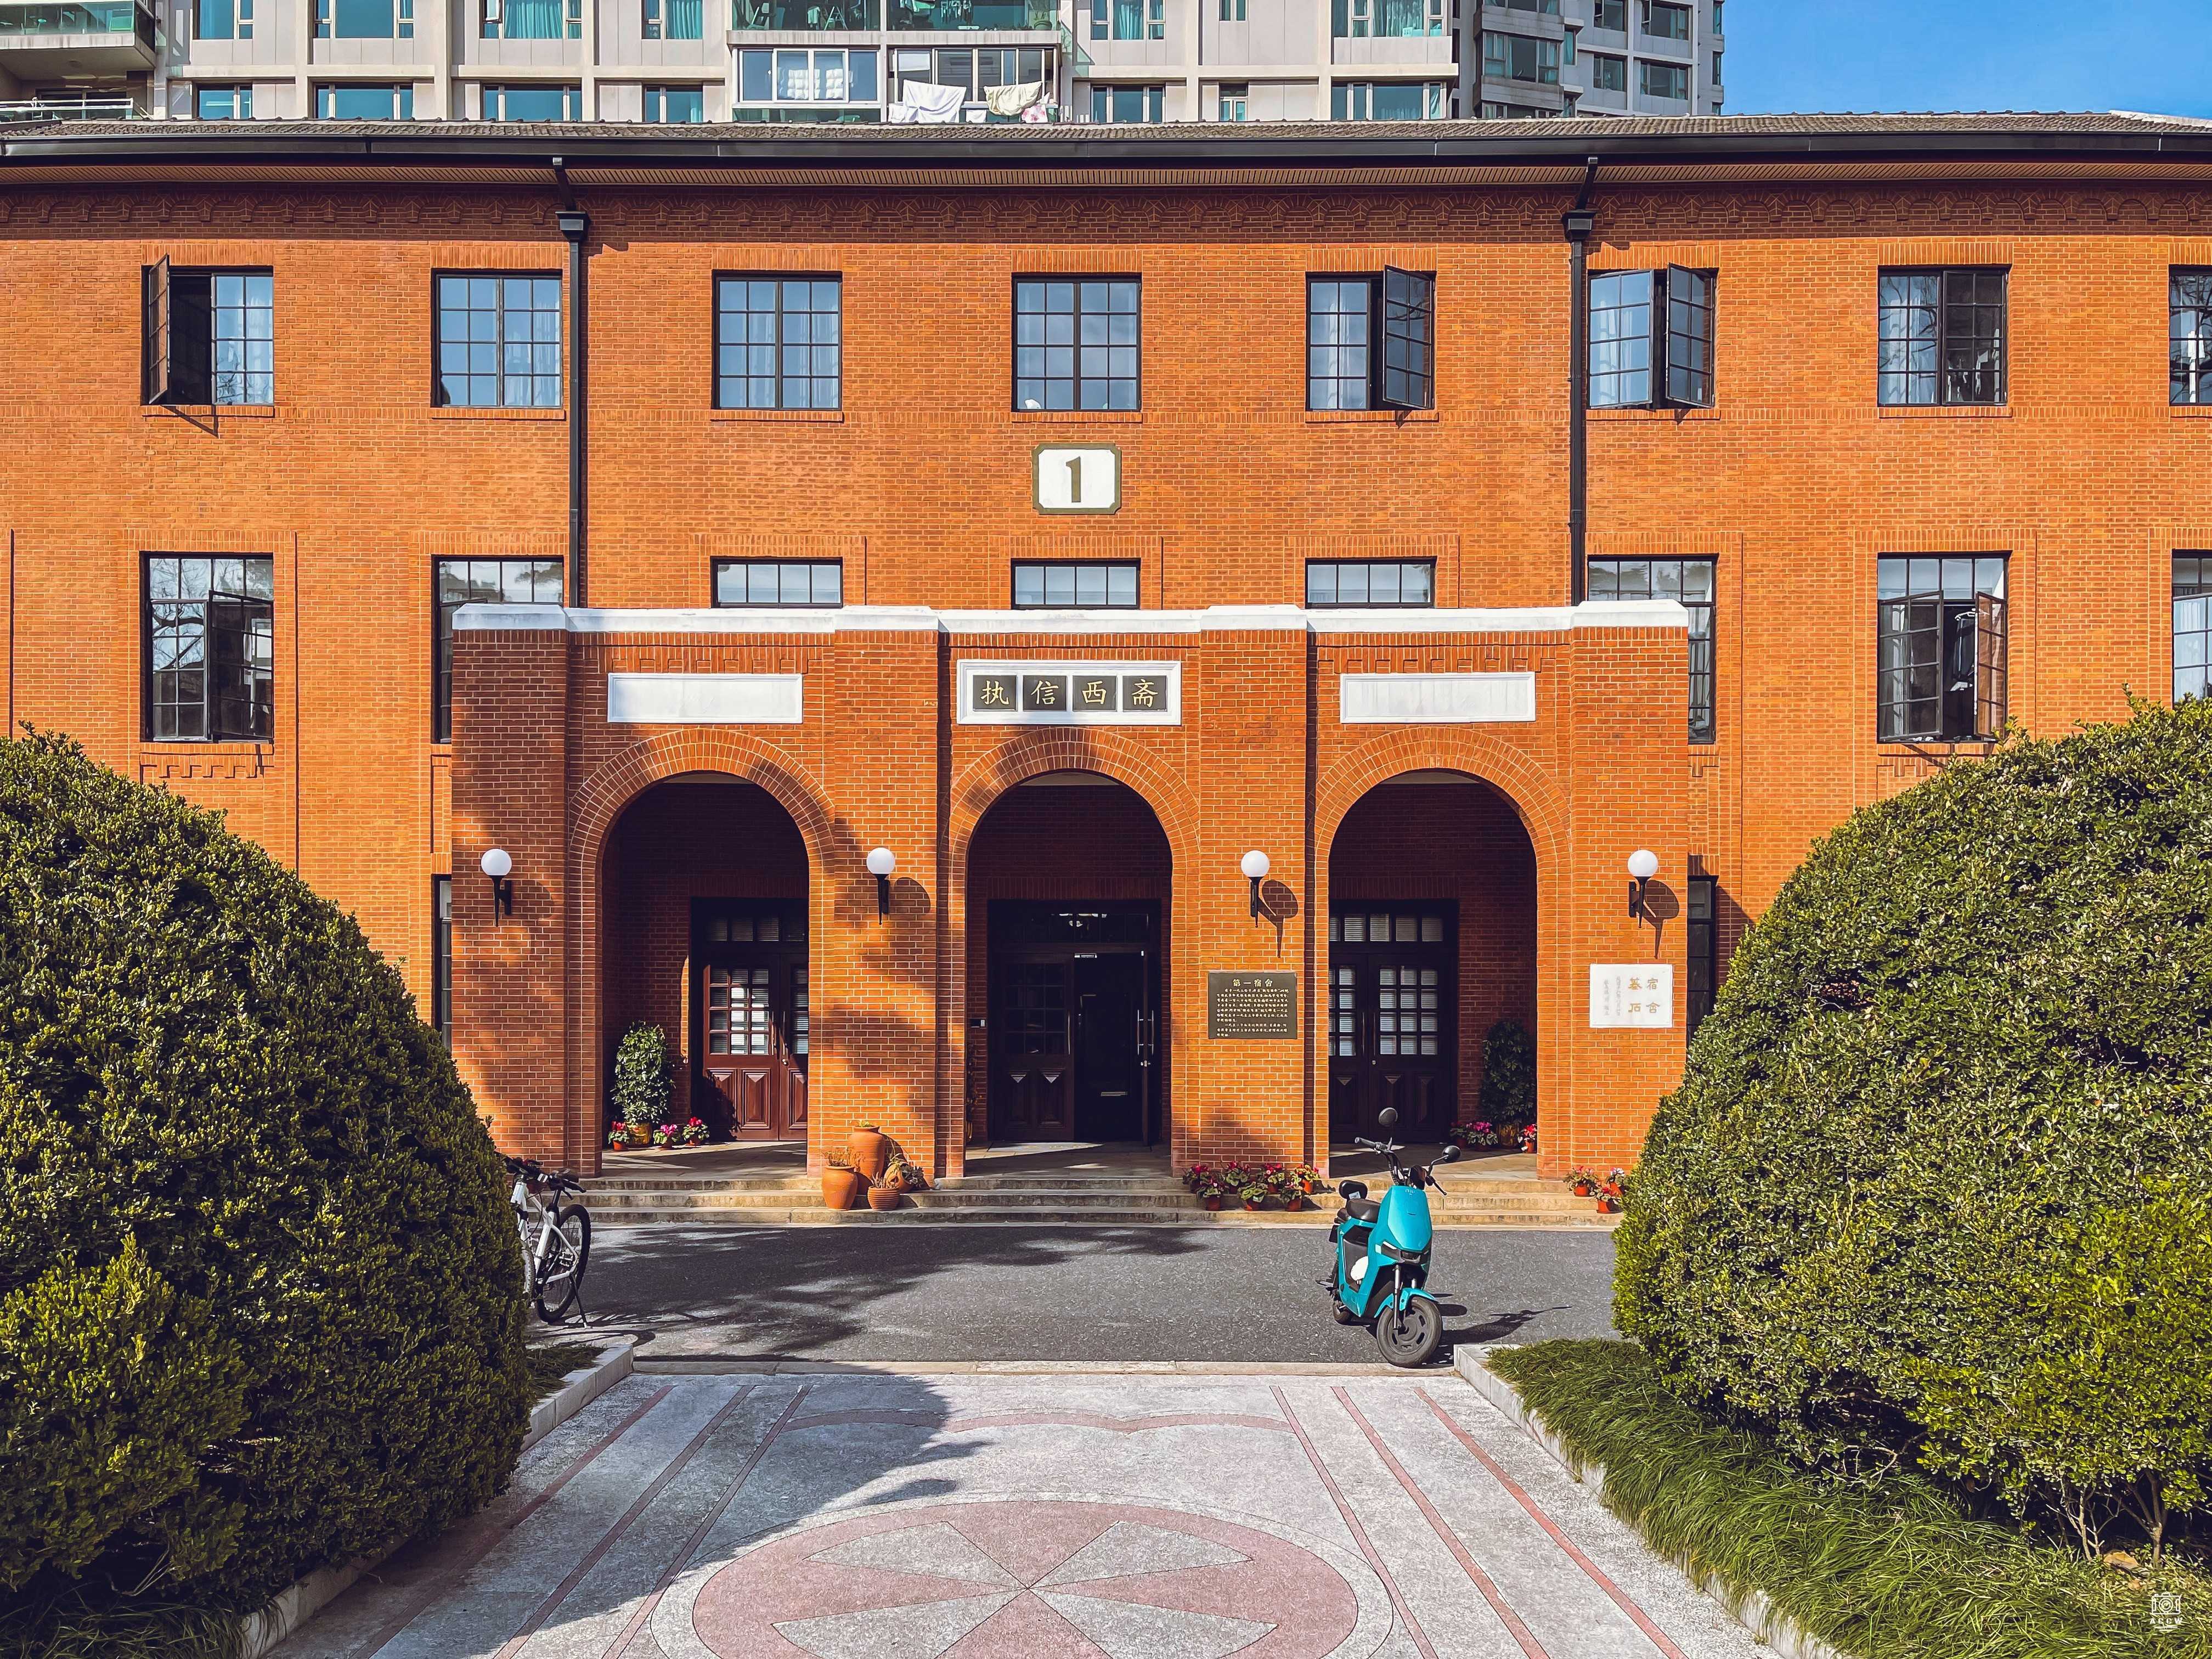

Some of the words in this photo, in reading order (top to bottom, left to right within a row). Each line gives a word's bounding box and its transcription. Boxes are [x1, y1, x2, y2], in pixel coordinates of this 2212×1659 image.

[1066, 456, 1081, 503] 1
[980, 679, 1159, 708] 执信西斋
[1233, 979, 1273, 987] 第一宿舍
[1628, 977, 1643, 1013] 基石
